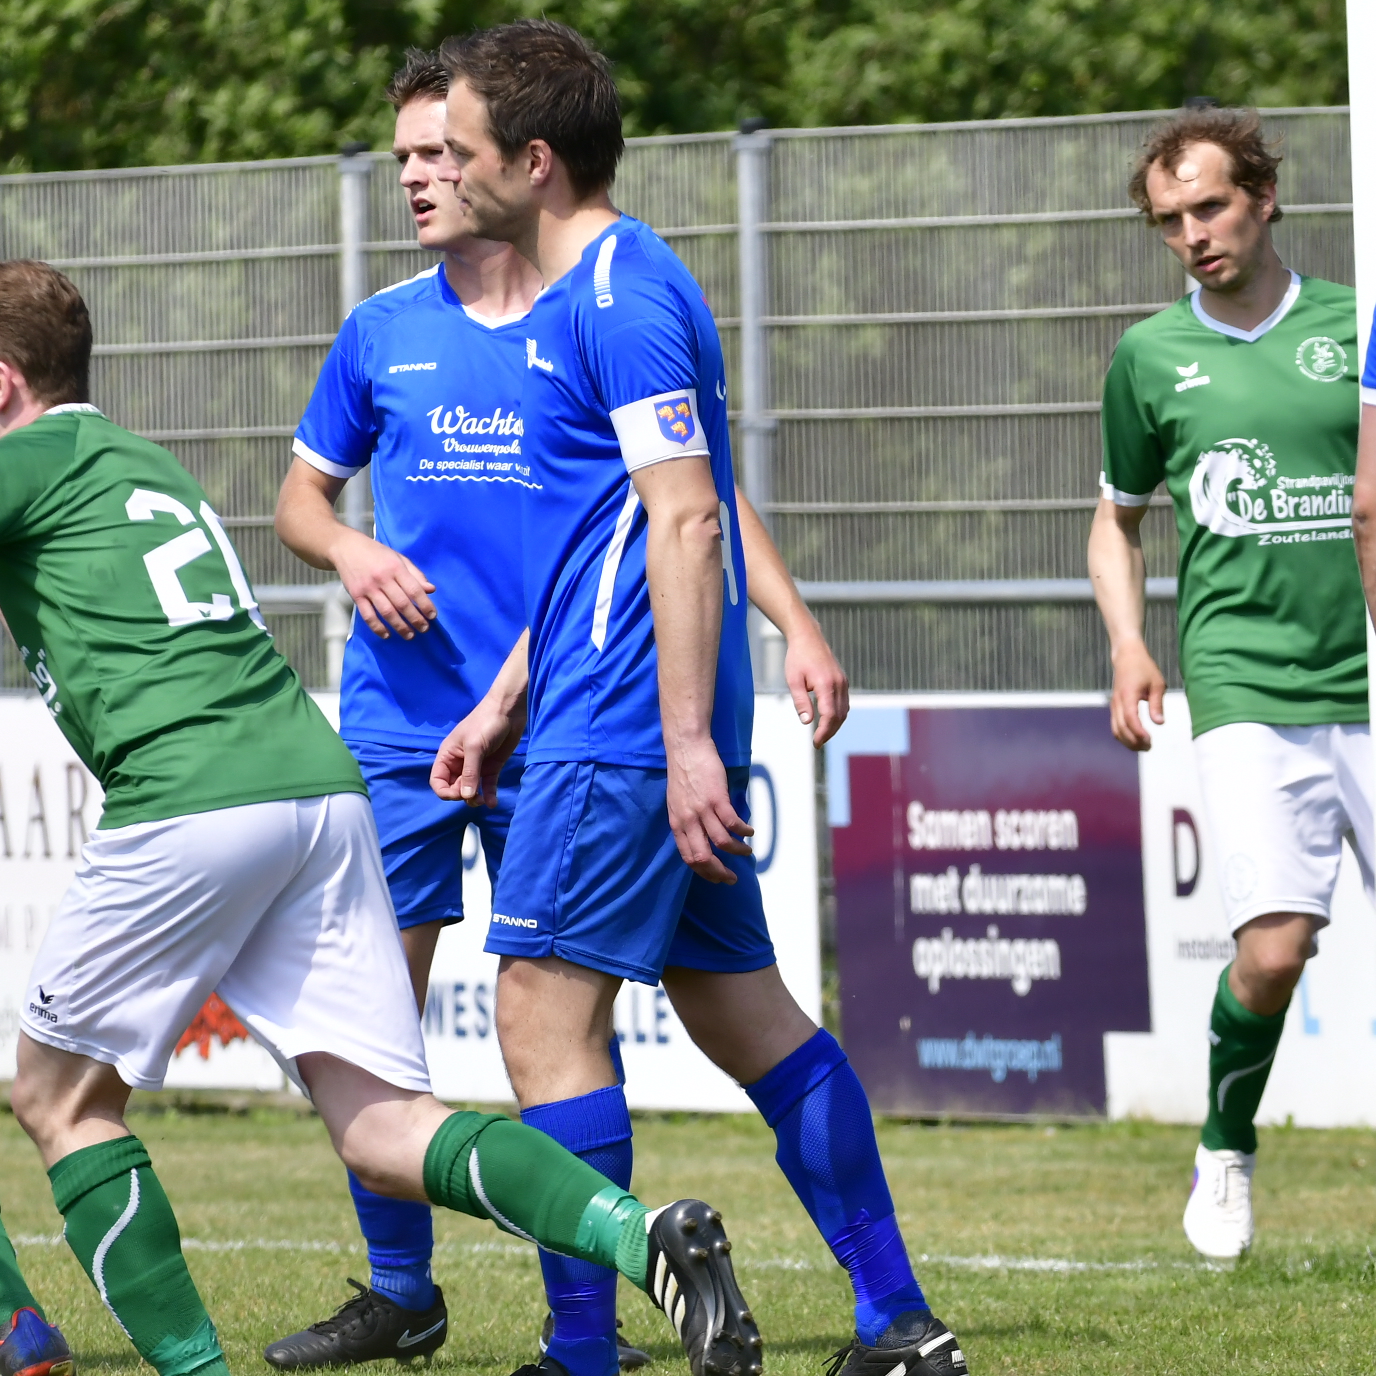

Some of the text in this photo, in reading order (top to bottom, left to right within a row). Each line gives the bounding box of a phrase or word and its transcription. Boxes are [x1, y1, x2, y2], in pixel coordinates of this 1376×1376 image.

[388, 361, 437, 374] STANNO
[419, 459, 434, 470] De
[436, 459, 484, 472] specialist
[486, 462, 513, 471] waar
[907, 800, 1079, 851] Samen scoren
[910, 863, 1088, 916] met duurzame
[491, 913, 538, 929] STANNO
[912, 924, 1062, 996] oplossingen
[29, 1002, 59, 1024] erima
